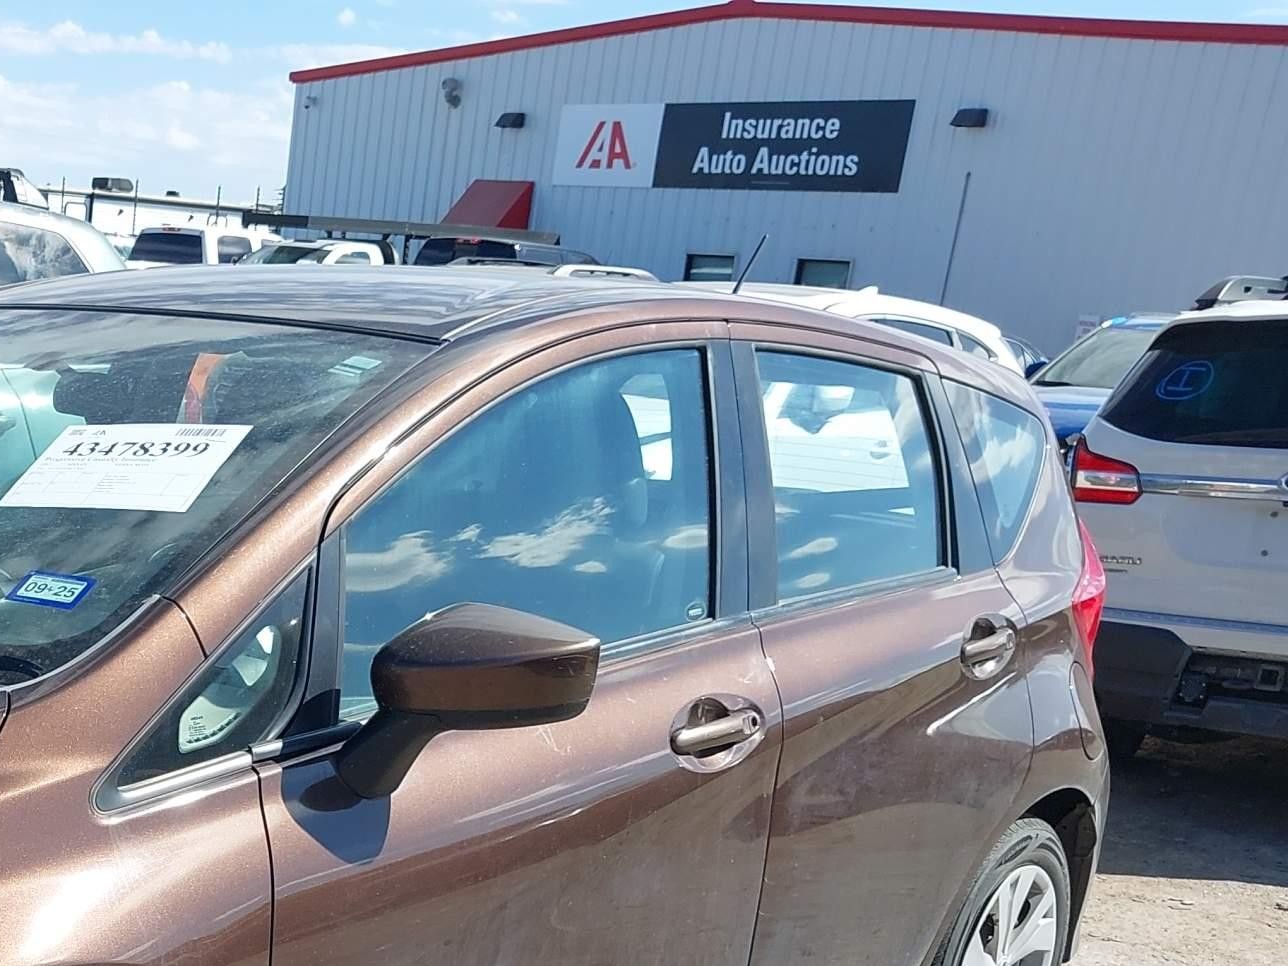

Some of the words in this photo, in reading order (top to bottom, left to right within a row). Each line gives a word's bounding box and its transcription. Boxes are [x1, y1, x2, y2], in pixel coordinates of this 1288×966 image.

[721, 111, 840, 139] Insurance
[691, 146, 746, 174] Auto
[750, 146, 859, 176] Auctions
[62, 441, 211, 458] 43478399
